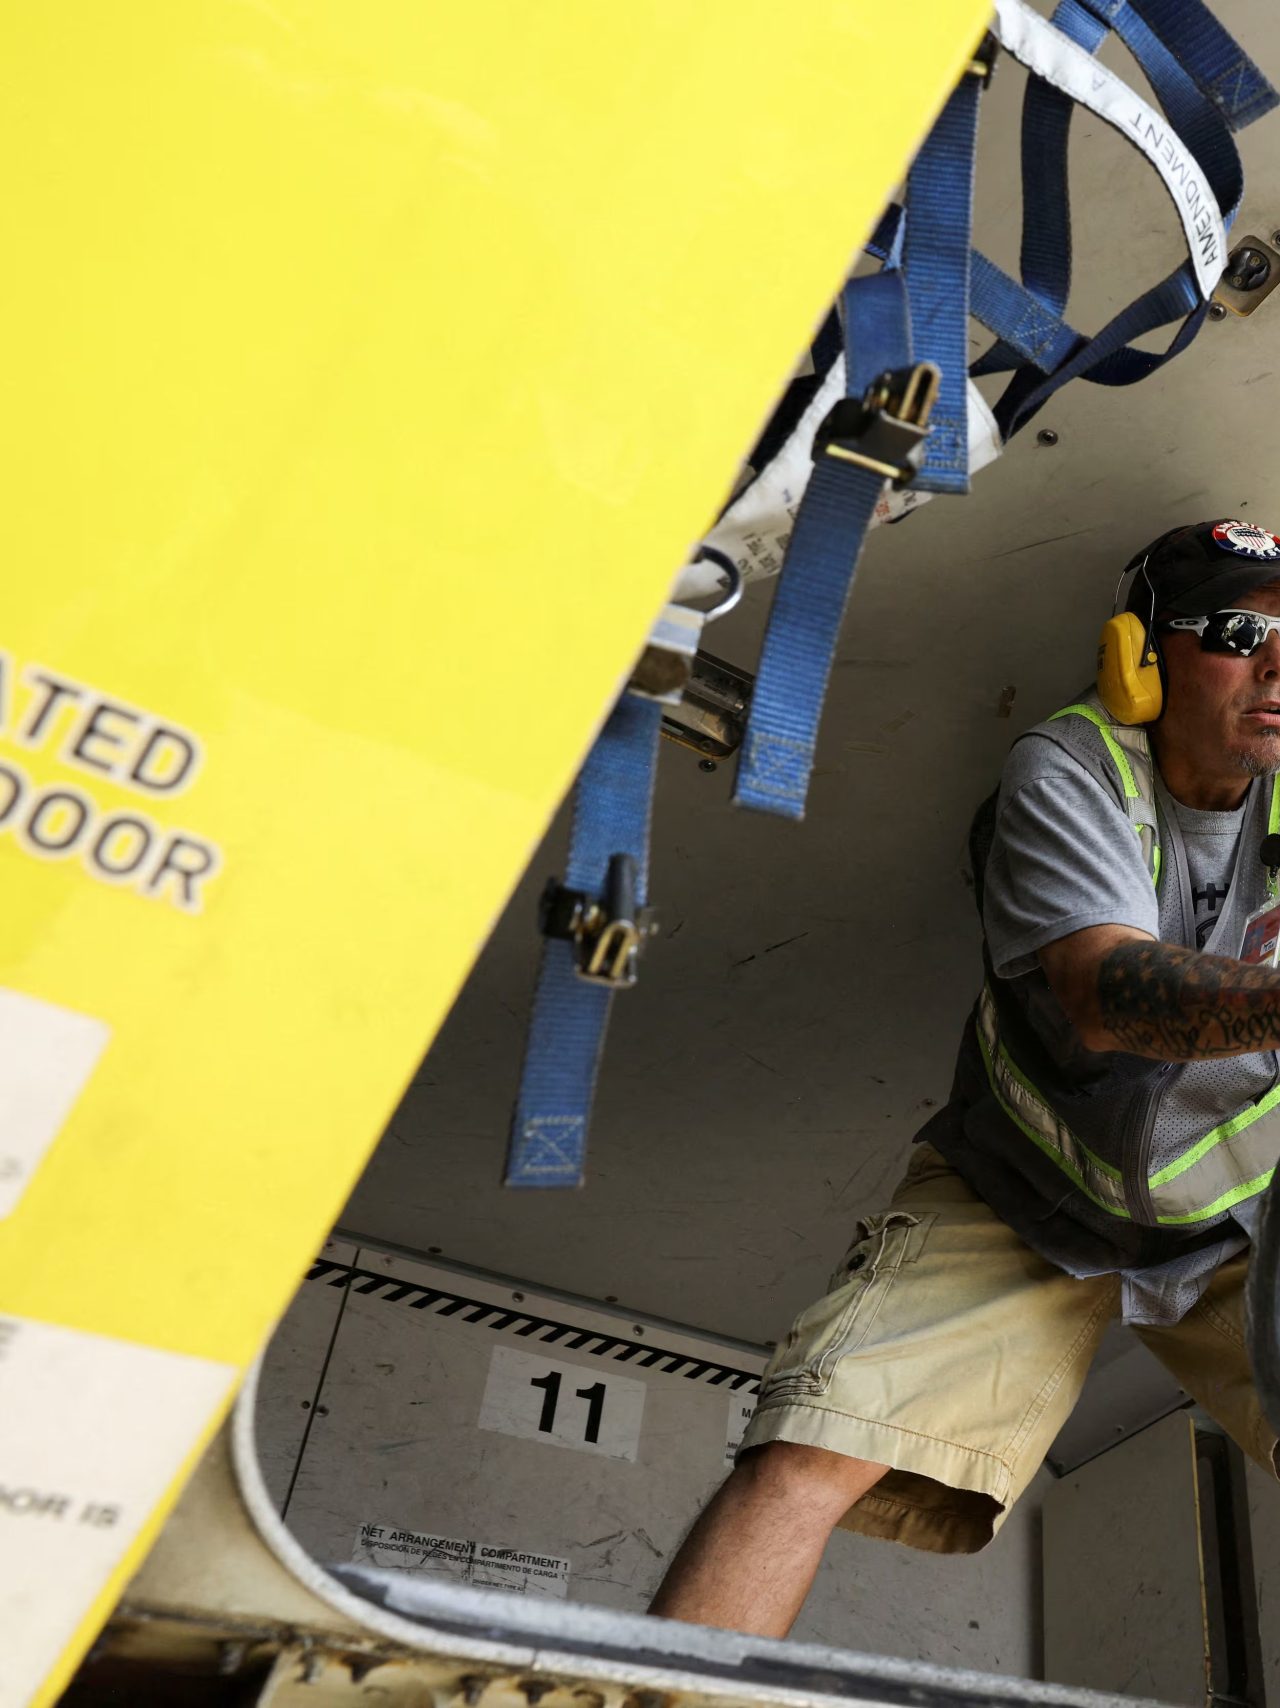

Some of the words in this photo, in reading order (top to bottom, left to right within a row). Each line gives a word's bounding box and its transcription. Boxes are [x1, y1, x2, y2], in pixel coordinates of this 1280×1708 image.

[1128, 112, 1219, 267] AMENDMENT
[0, 657, 196, 791] TED
[530, 1371, 606, 1444] 11
[361, 1526, 385, 1539] NET
[481, 1547, 561, 1569] COMPARTMENT
[563, 1562, 569, 1571] 1
[522, 1567, 532, 1575] DE
[533, 1569, 558, 1579] CARGA
